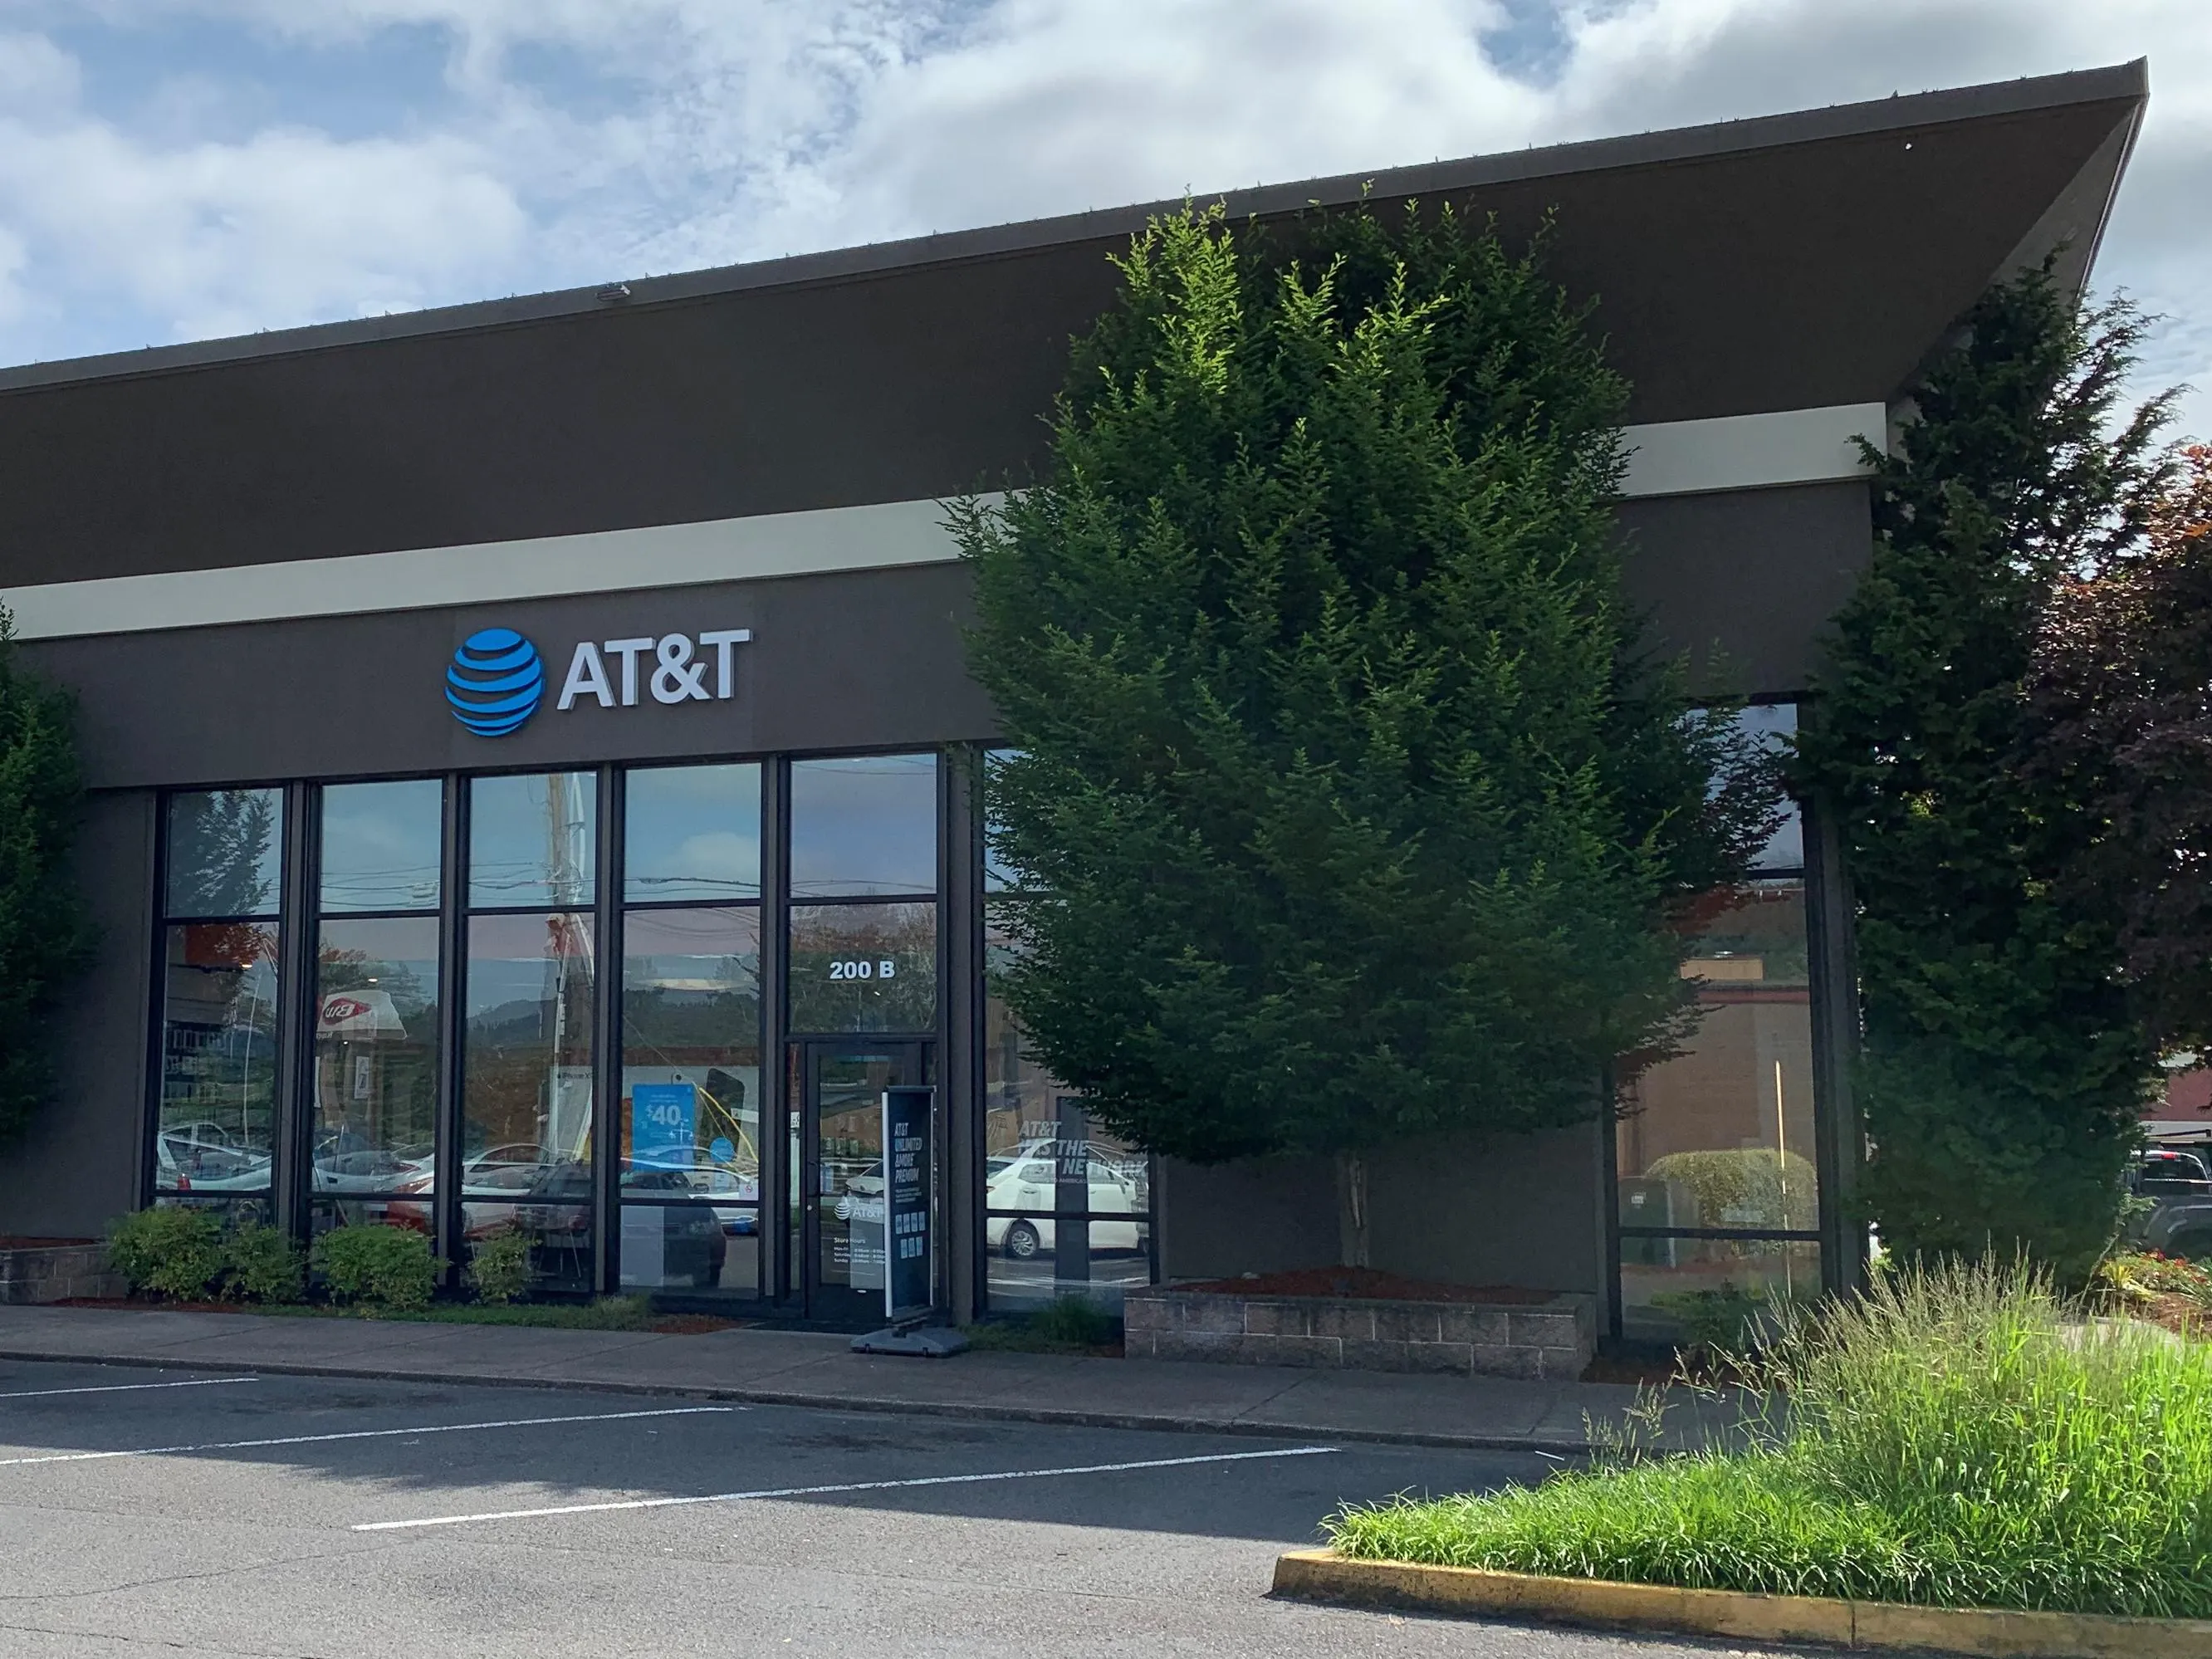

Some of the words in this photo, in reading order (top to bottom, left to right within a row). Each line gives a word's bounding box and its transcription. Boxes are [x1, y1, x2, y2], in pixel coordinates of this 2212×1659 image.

[557, 629, 752, 711] AT&T
[830, 961, 872, 979] 200
[879, 960, 895, 978] B
[894, 1122, 909, 1137] AT&T
[1018, 1120, 1062, 1138] AT&T
[1056, 1139, 1089, 1157] THE
[852, 1207, 884, 1218] AT&T
